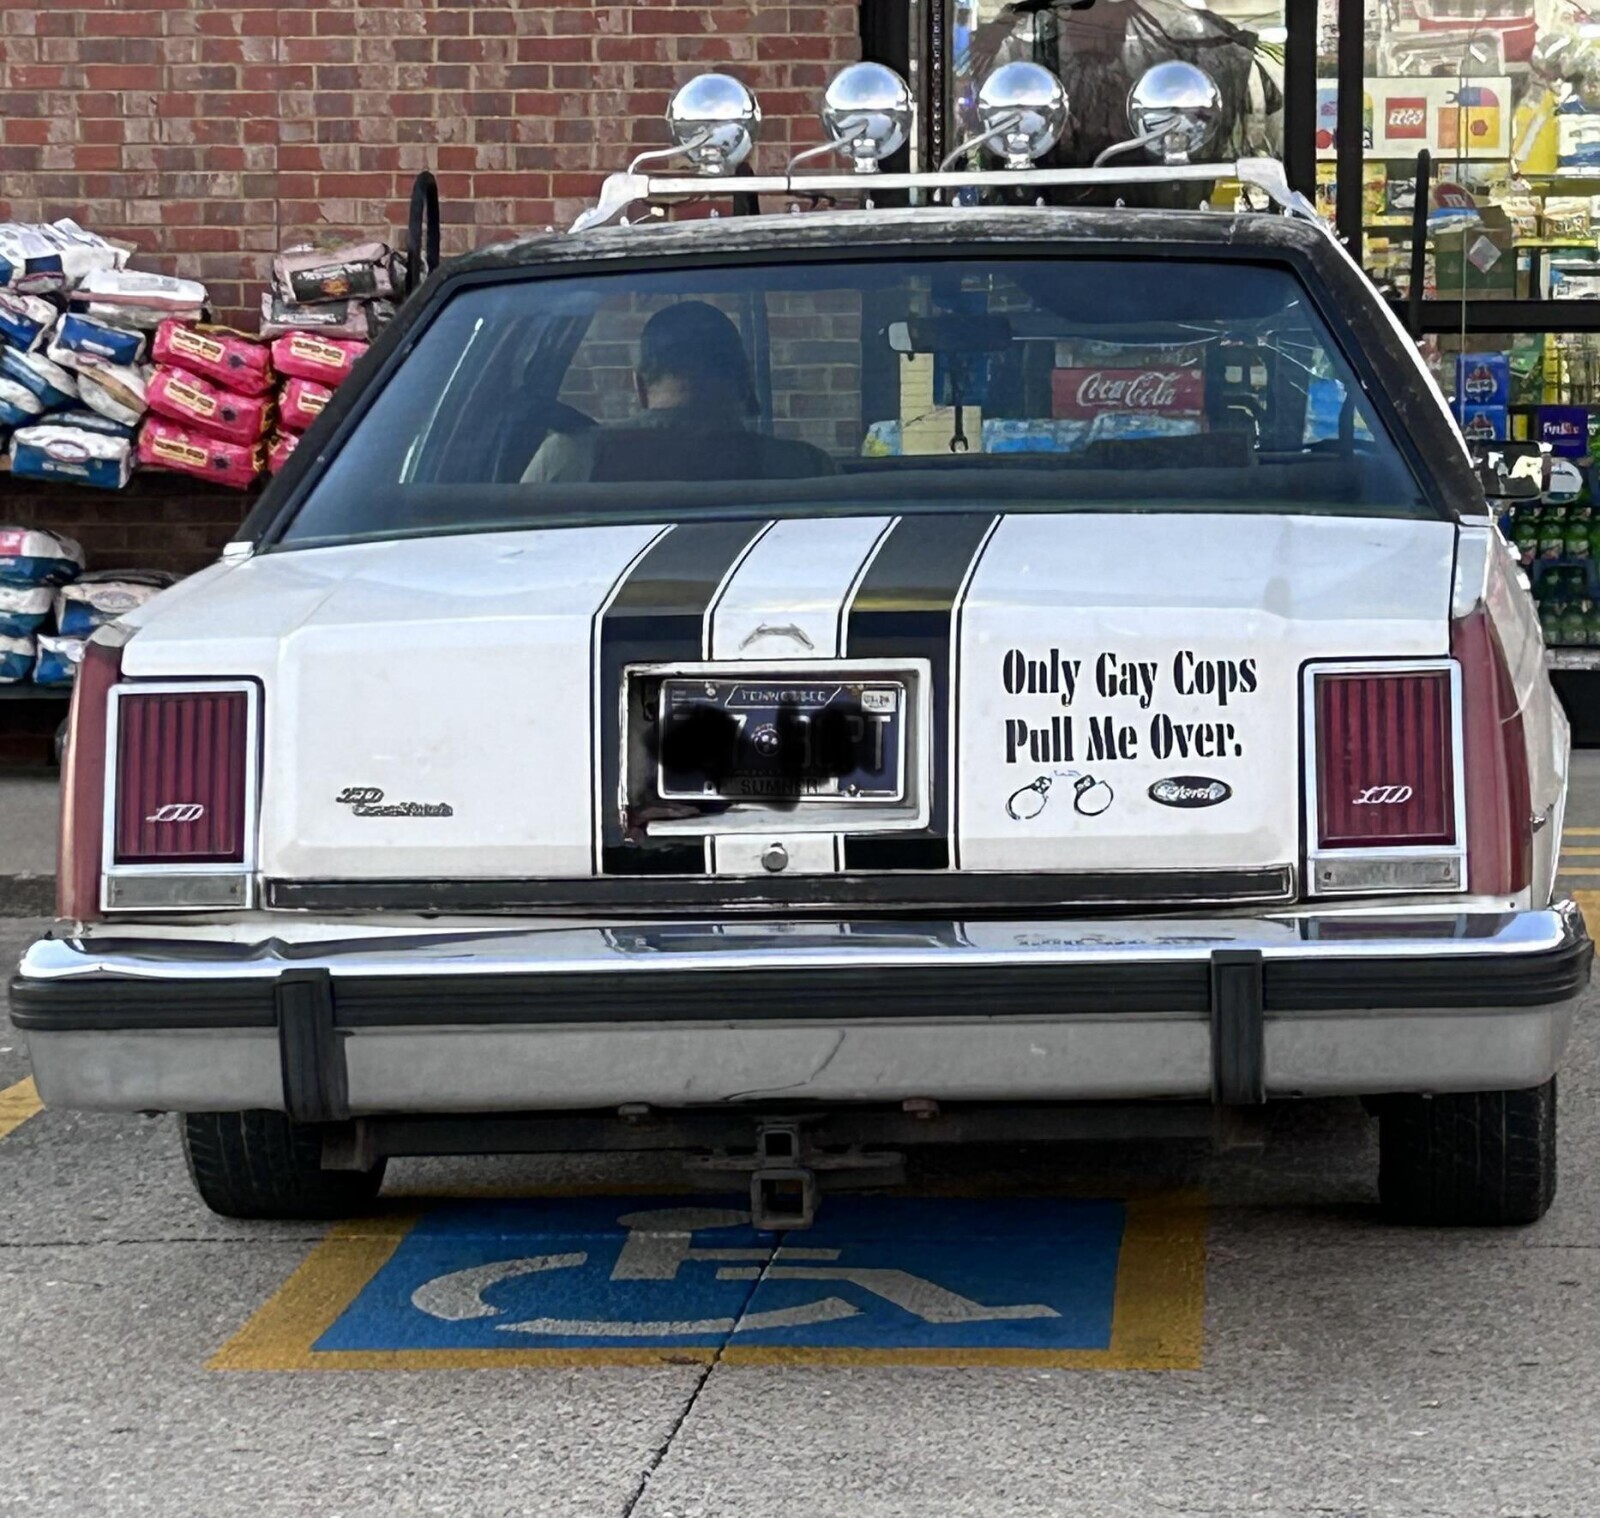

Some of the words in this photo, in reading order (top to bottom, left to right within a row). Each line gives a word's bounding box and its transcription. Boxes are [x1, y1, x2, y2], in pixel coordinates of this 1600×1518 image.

[1003, 649, 1082, 706] Only
[1095, 652, 1158, 708] Gay
[1173, 650, 1257, 705] Cops
[1005, 716, 1074, 763] Pull
[1087, 716, 1137, 761] Me
[1150, 713, 1242, 759] Over.
